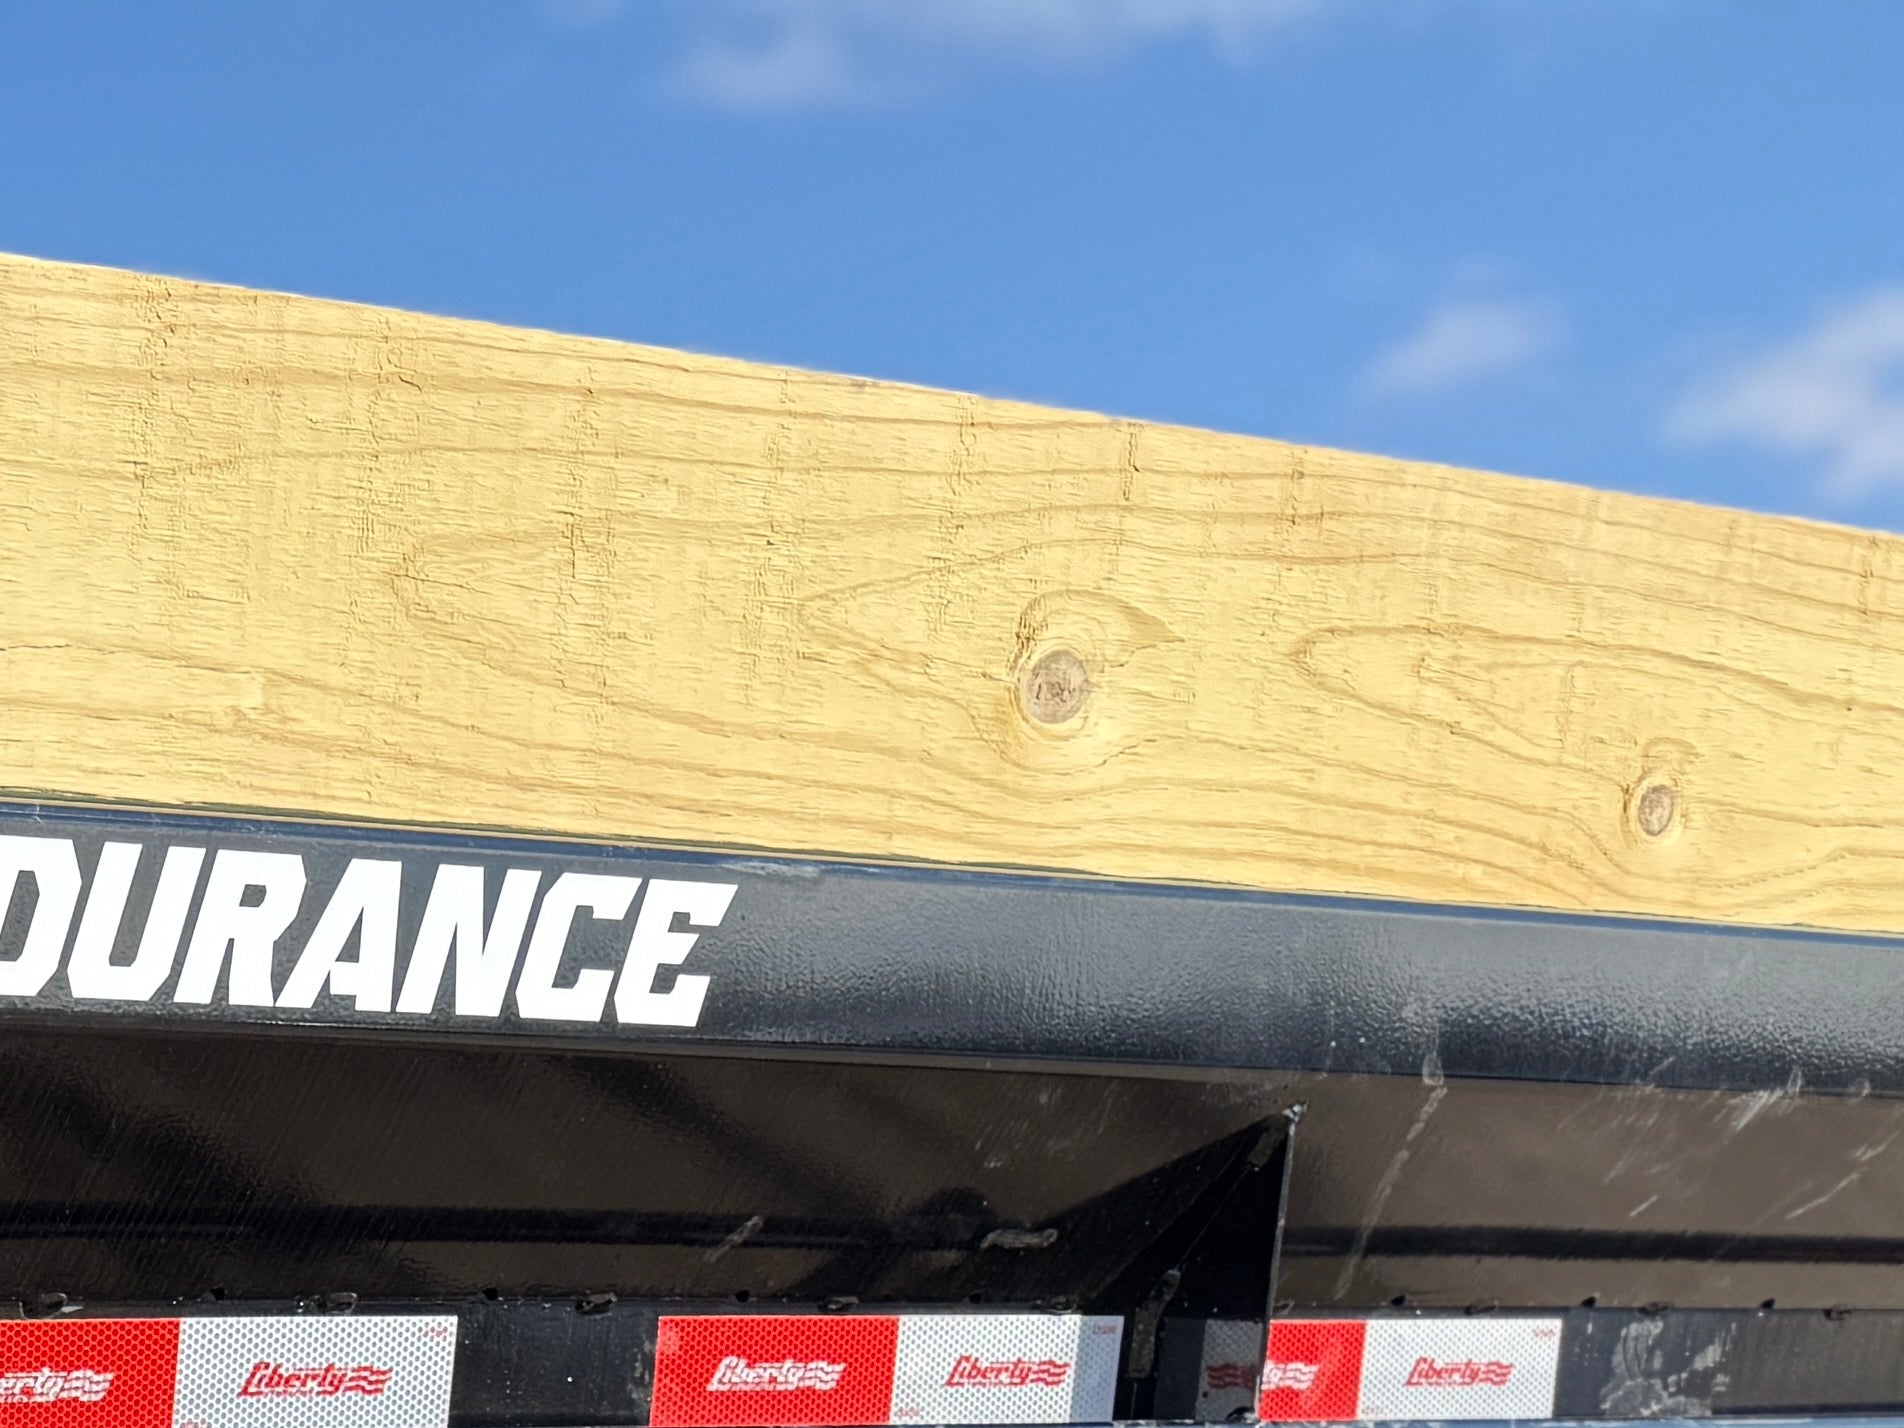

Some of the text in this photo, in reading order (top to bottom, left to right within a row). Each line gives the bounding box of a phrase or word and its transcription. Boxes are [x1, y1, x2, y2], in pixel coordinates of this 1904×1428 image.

[239, 1360, 350, 1399] Liberty
[706, 1355, 808, 1392] Liberty
[945, 1354, 1036, 1388] Liberty
[1403, 1355, 1484, 1387] Liberty
